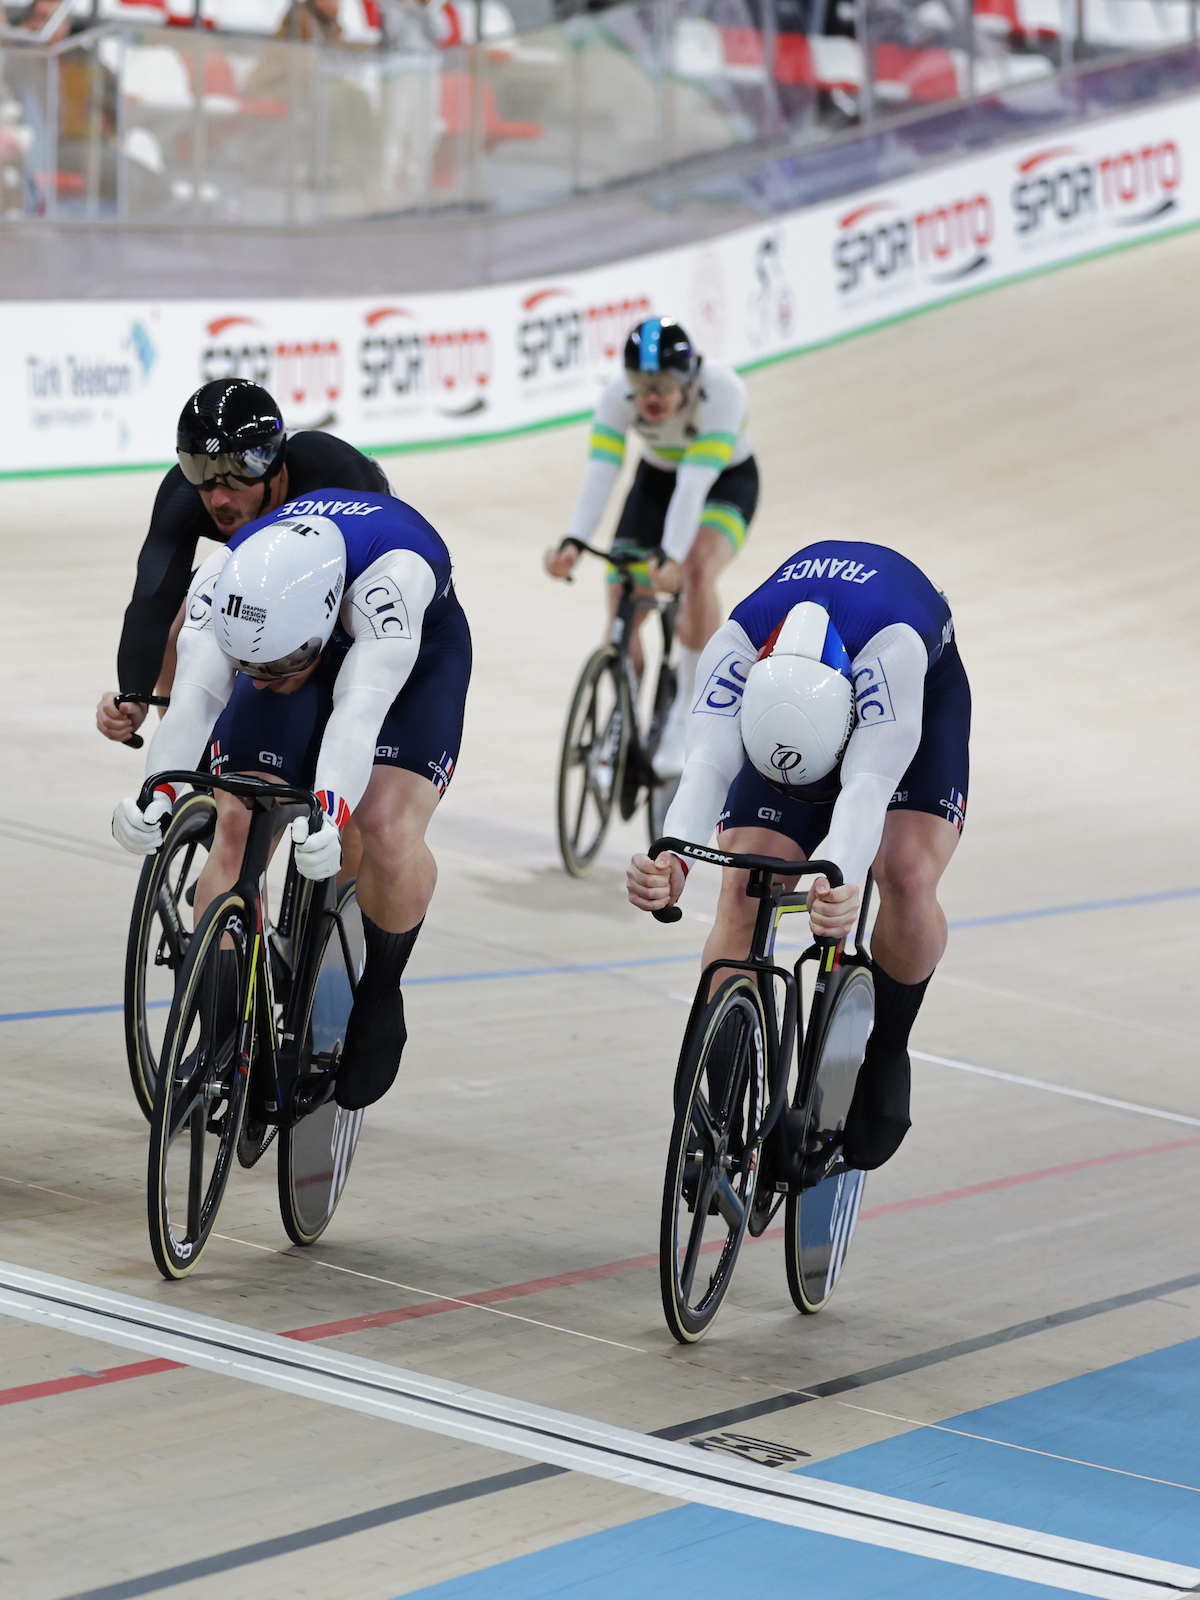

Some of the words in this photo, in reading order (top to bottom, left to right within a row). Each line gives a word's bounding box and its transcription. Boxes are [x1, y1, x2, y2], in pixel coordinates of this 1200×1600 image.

[1012, 139, 1183, 235] SPORTOTO
[834, 194, 995, 293] SPORTOTO
[277, 500, 384, 518] FRANCE
[777, 558, 878, 584] FRANCE
[241, 604, 268, 614] GRAPHIC
[241, 609, 267, 619] DESIGN
[240, 615, 266, 625] AGENCY
[683, 845, 735, 864] LOOK
